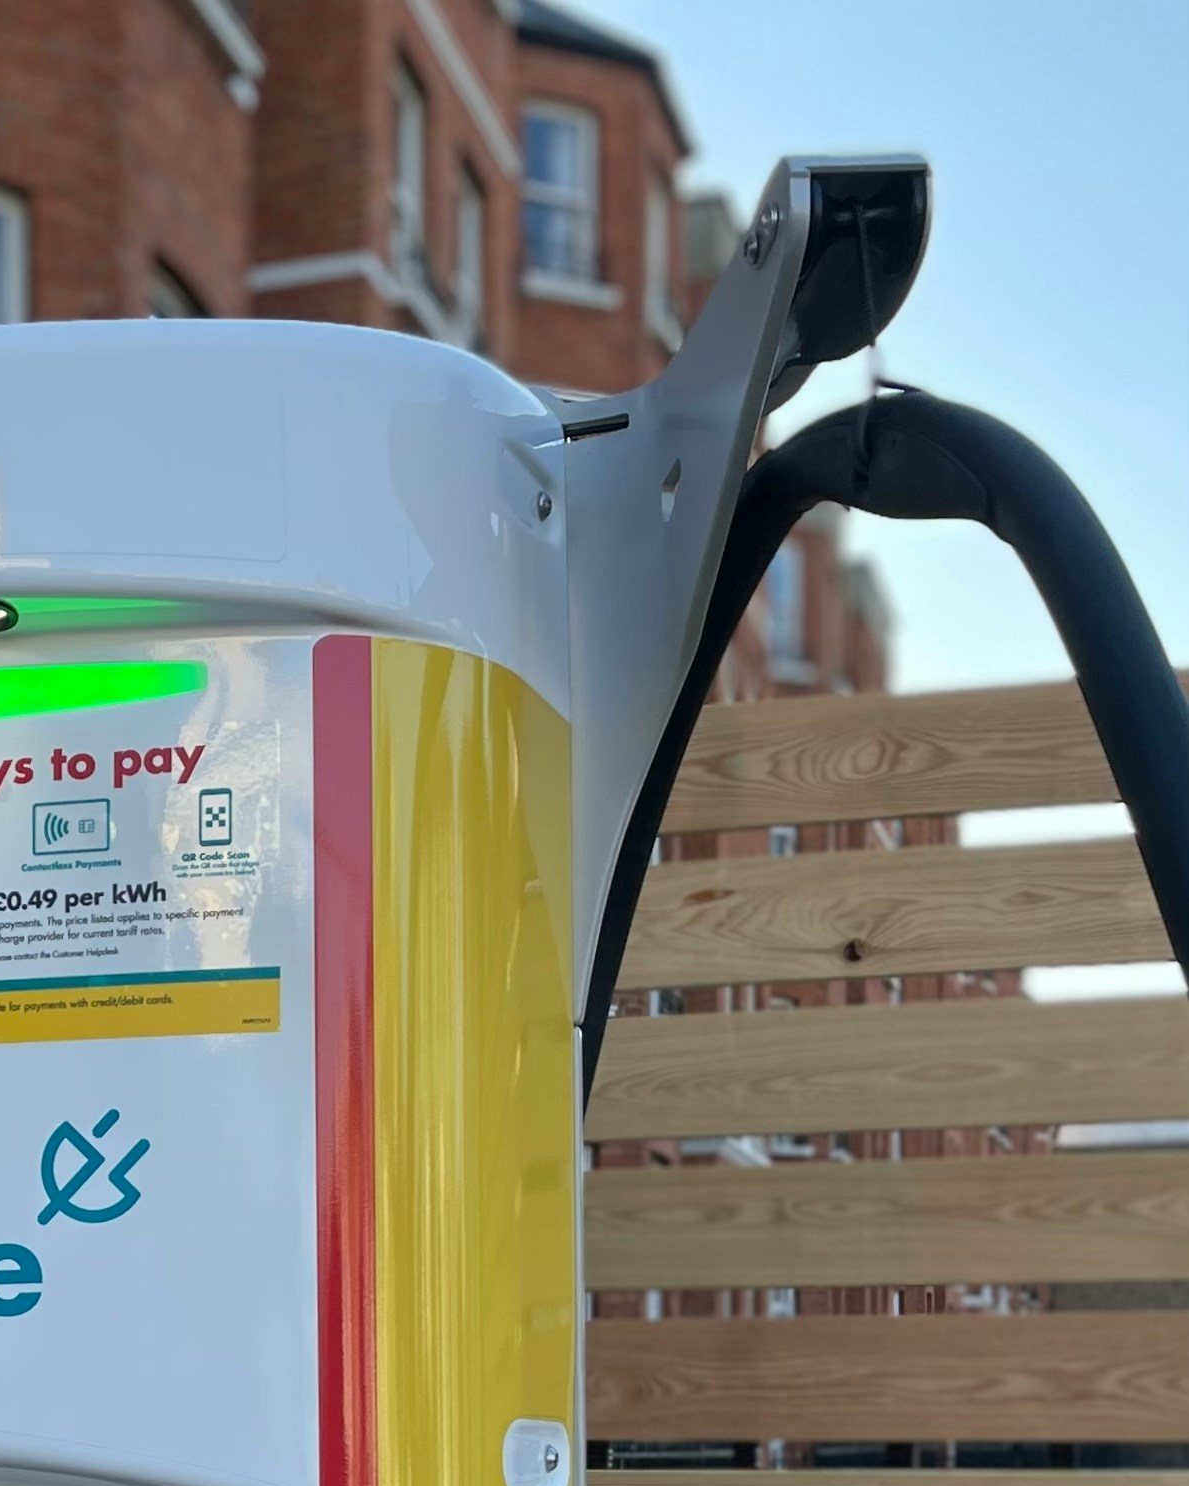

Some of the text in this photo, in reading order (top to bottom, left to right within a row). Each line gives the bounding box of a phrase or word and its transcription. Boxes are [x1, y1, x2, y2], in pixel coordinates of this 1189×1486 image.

[51, 749, 96, 780] to
[113, 744, 205, 788] pay
[75, 859, 121, 870] Payments
[182, 851, 249, 862] QR Code Scan
[64, 889, 104, 913] per
[112, 880, 166, 906] kWh
[47, 916, 62, 927] The
[65, 915, 88, 927] price
[91, 913, 114, 923] listed
[116, 912, 150, 923] applies
[153, 911, 163, 920] to
[165, 908, 199, 921] specific
[202, 906, 244, 919] payment
[27, 930, 64, 945] provider
[67, 928, 80, 939] for
[82, 928, 114, 938] current
[116, 925, 138, 936] tariff
[52, 949, 83, 958] Customer
[9, 1001, 22, 1011] for
[24, 1000, 67, 1013] payments
[69, 999, 89, 1009] with
[91, 995, 144, 1007] credit/debit
